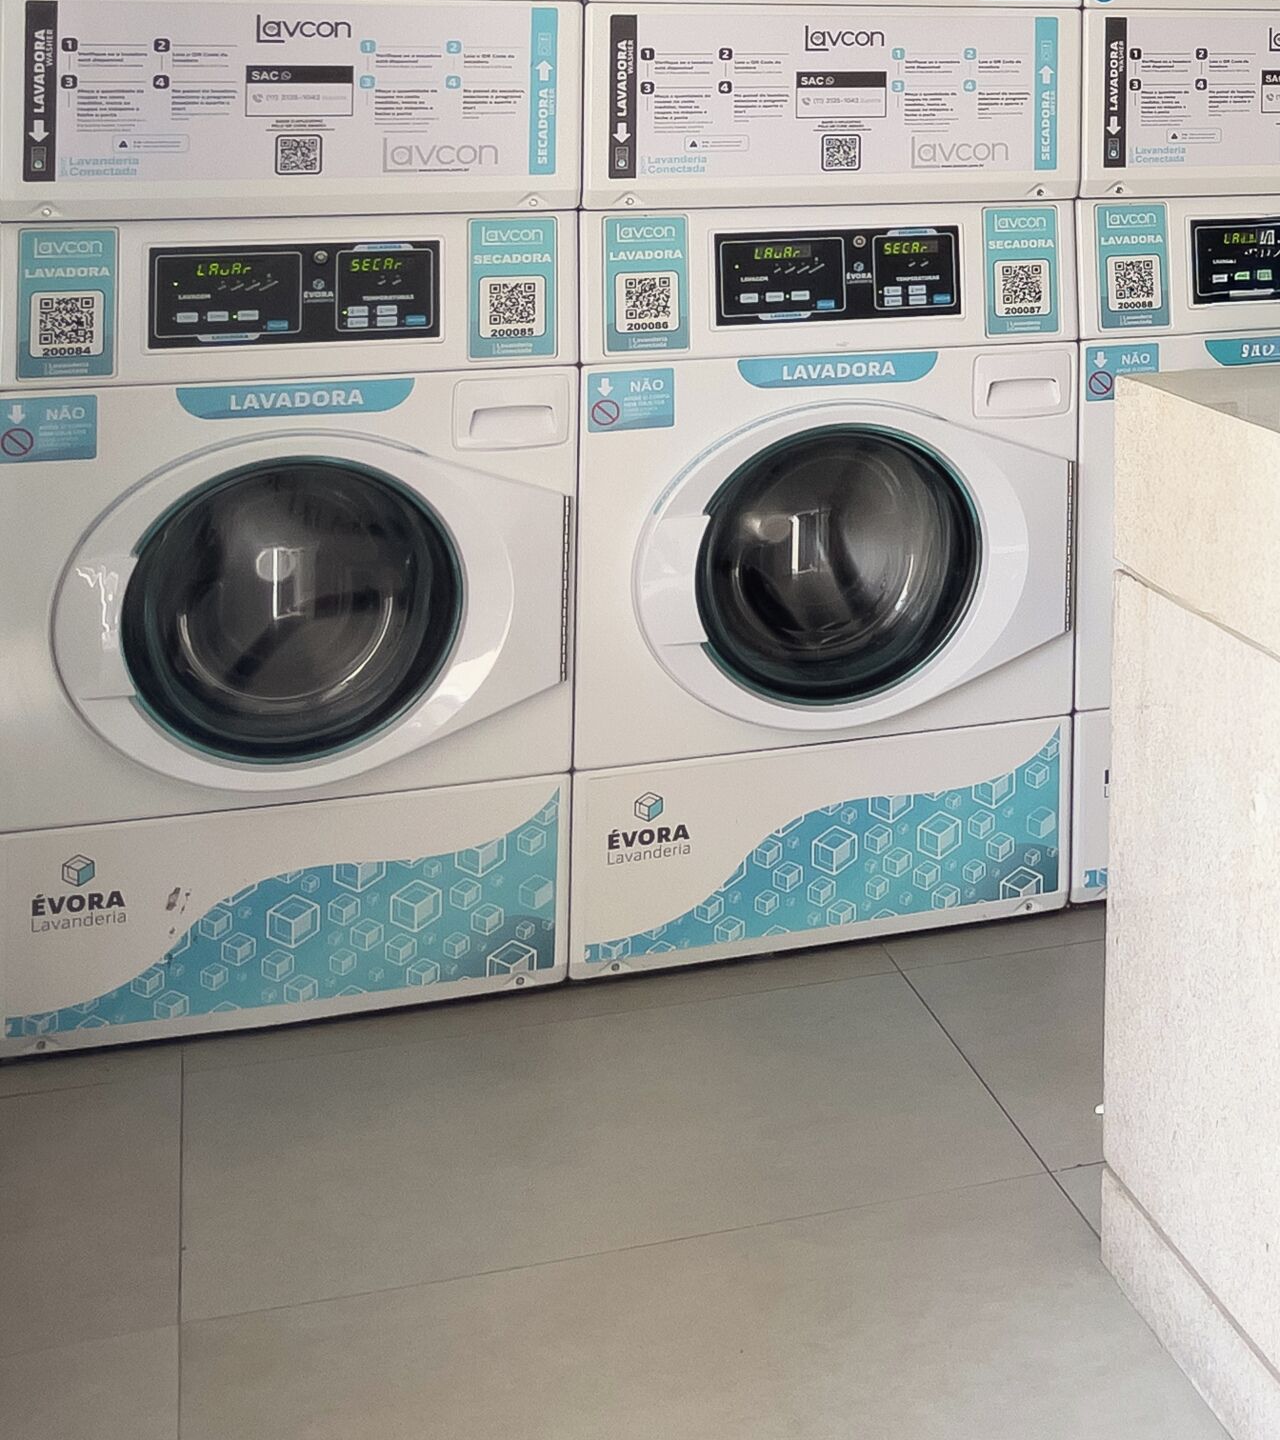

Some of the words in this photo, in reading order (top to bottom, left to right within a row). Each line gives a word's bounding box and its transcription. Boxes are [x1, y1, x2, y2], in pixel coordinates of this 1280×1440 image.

[33, 28, 46, 113] LAVADORA
[251, 70, 280, 81] SAC
[617, 39, 627, 117] LAVADORA
[1110, 41, 1118, 111] LAVADORA
[801, 76, 824, 86] SAC
[538, 88, 548, 164] SECADORA
[1041, 91, 1050, 160] SECADORA
[988, 239, 1054, 250] SECADORA
[1100, 234, 1163, 246] LAVADORA
[473, 253, 552, 265] SECADORA
[609, 249, 683, 261] LAVADORA
[25, 266, 110, 279] LAVADORA
[1004, 306, 1041, 315] 200087
[490, 328, 534, 338] 200085
[627, 321, 668, 331] 200086
[42, 346, 91, 357] 200084
[1121, 352, 1150, 365] NÃO
[782, 361, 896, 381] LAVADORA
[630, 378, 664, 393] NÃO
[229, 388, 364, 412] LAVADORA
[46, 404, 85, 421] NÃO
[607, 822, 690, 851] ÉVORA
[607, 840, 691, 866] Lavanderia
[31, 889, 126, 917] ÉVORA
[31, 910, 127, 933] Lavanderia
